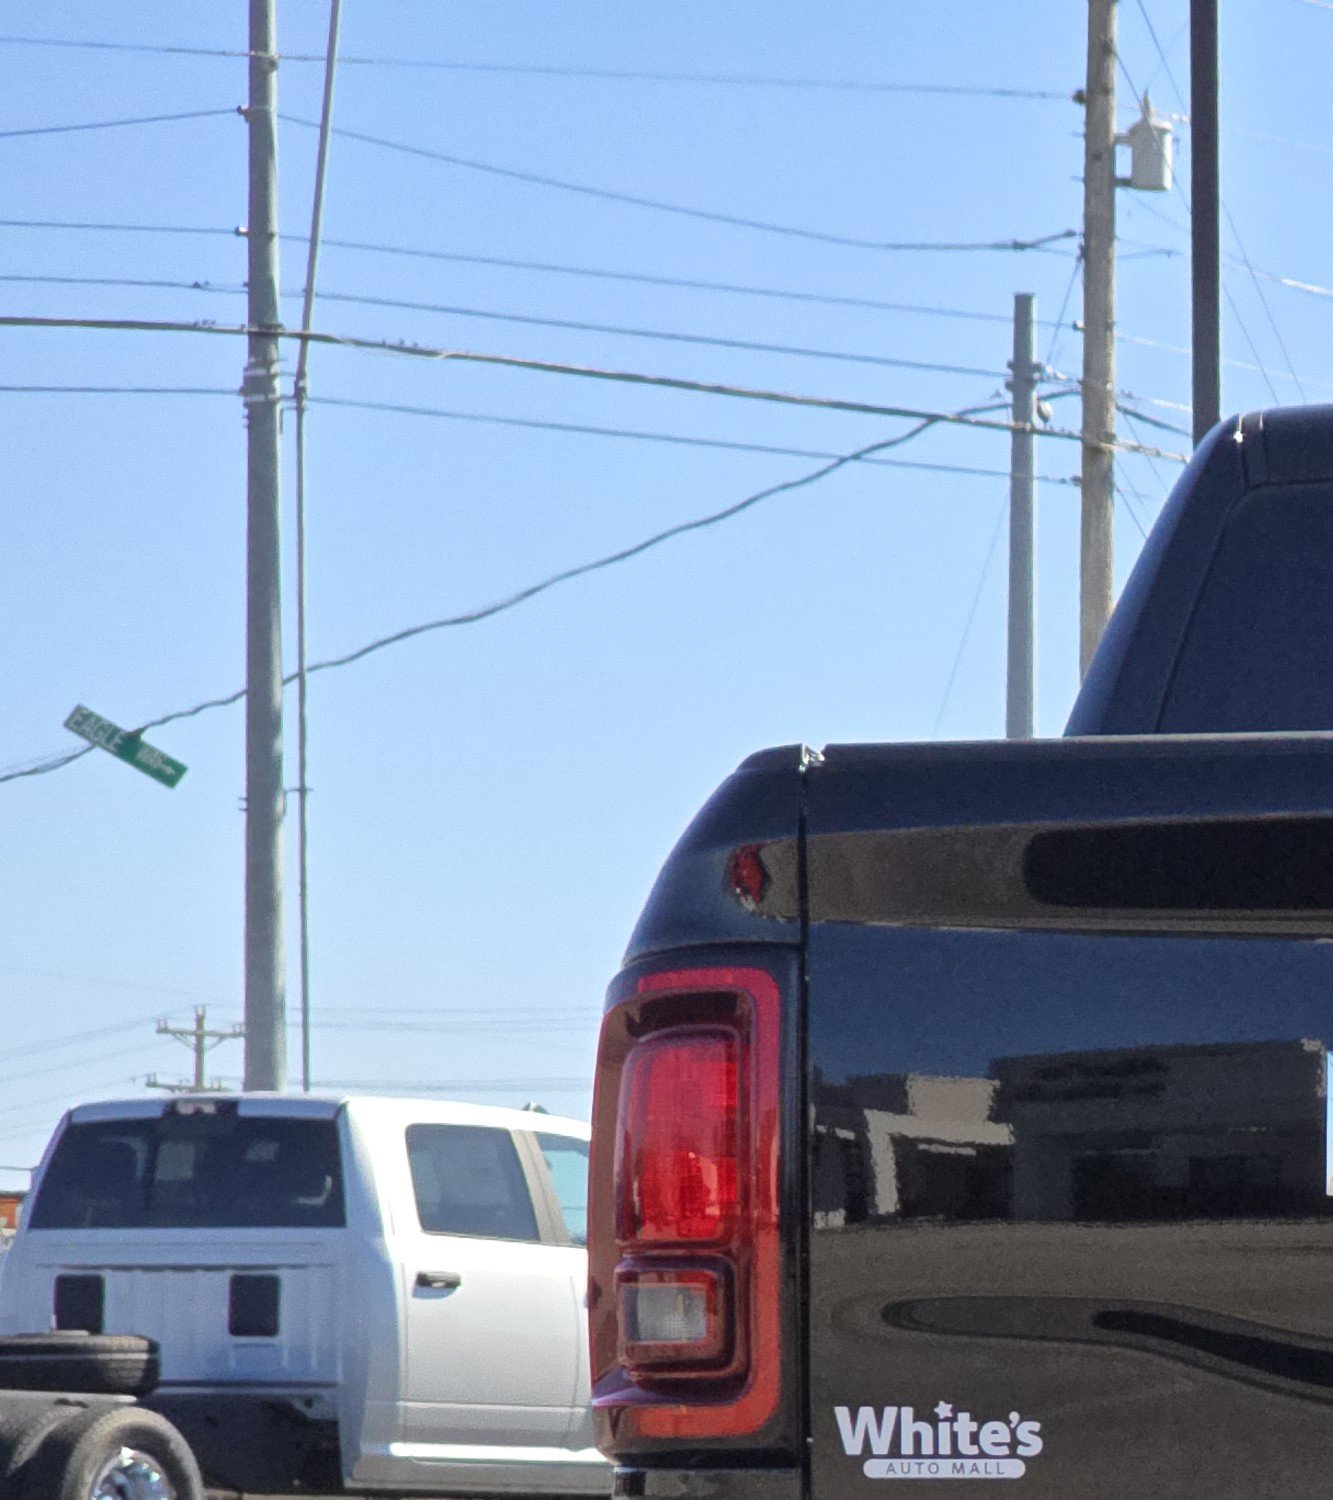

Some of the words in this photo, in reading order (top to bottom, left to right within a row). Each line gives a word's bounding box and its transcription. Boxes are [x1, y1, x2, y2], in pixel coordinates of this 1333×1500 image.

[834, 1400, 1043, 1456] White's
[885, 1462, 940, 1475] AUTO
[951, 1462, 1005, 1475] MALL
